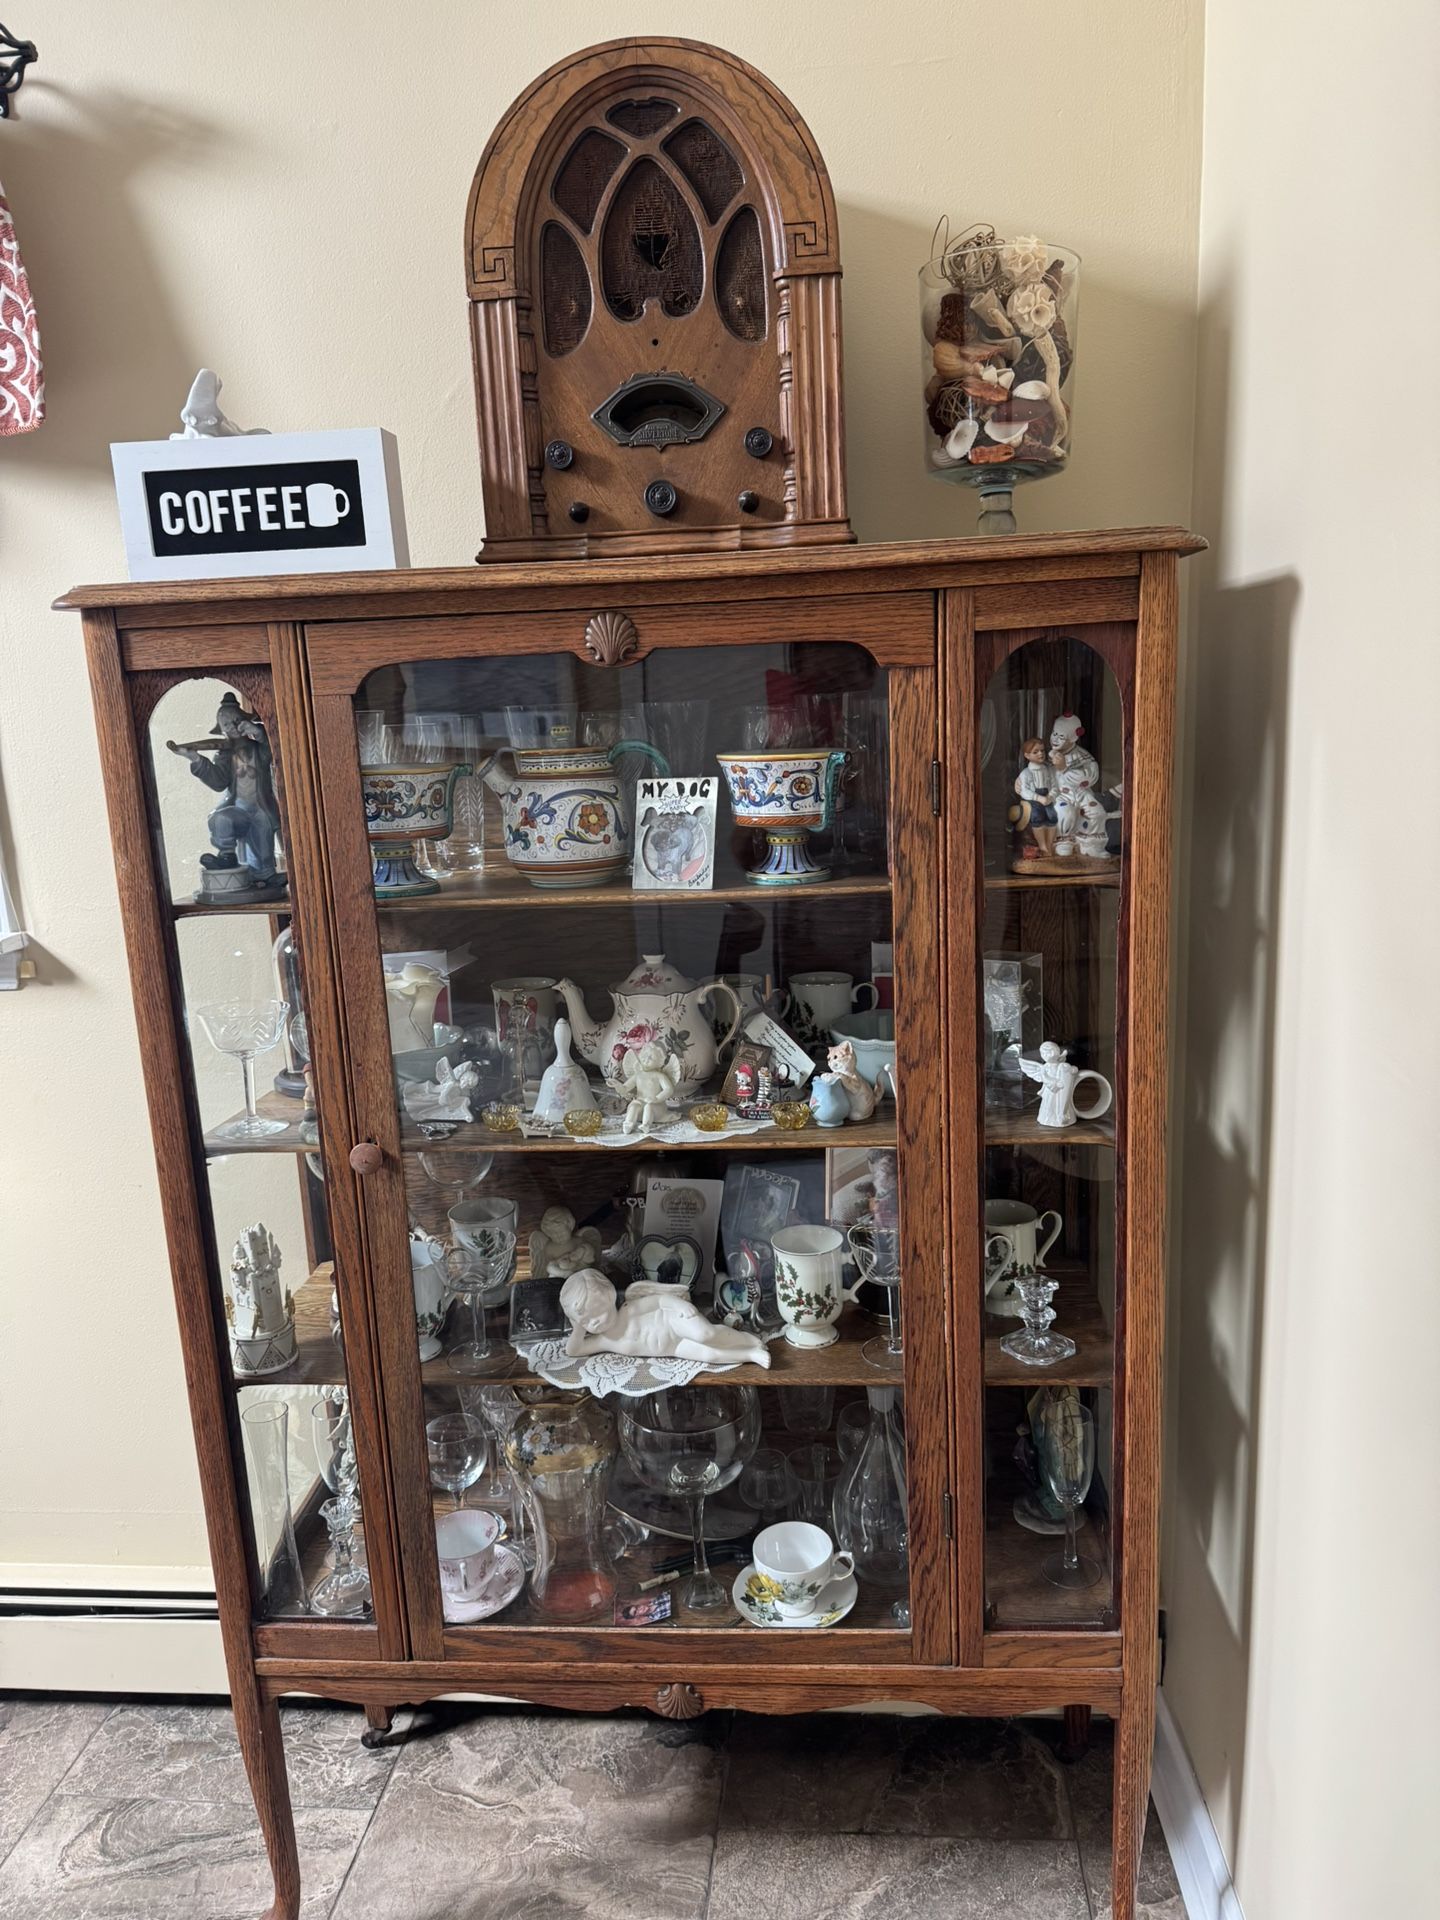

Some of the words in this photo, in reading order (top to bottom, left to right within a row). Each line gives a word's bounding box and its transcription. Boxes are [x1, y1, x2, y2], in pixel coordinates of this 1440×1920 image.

[159, 486, 306, 535] COFFEE
[642, 781, 669, 799] MY
[676, 779, 711, 799] DOG
